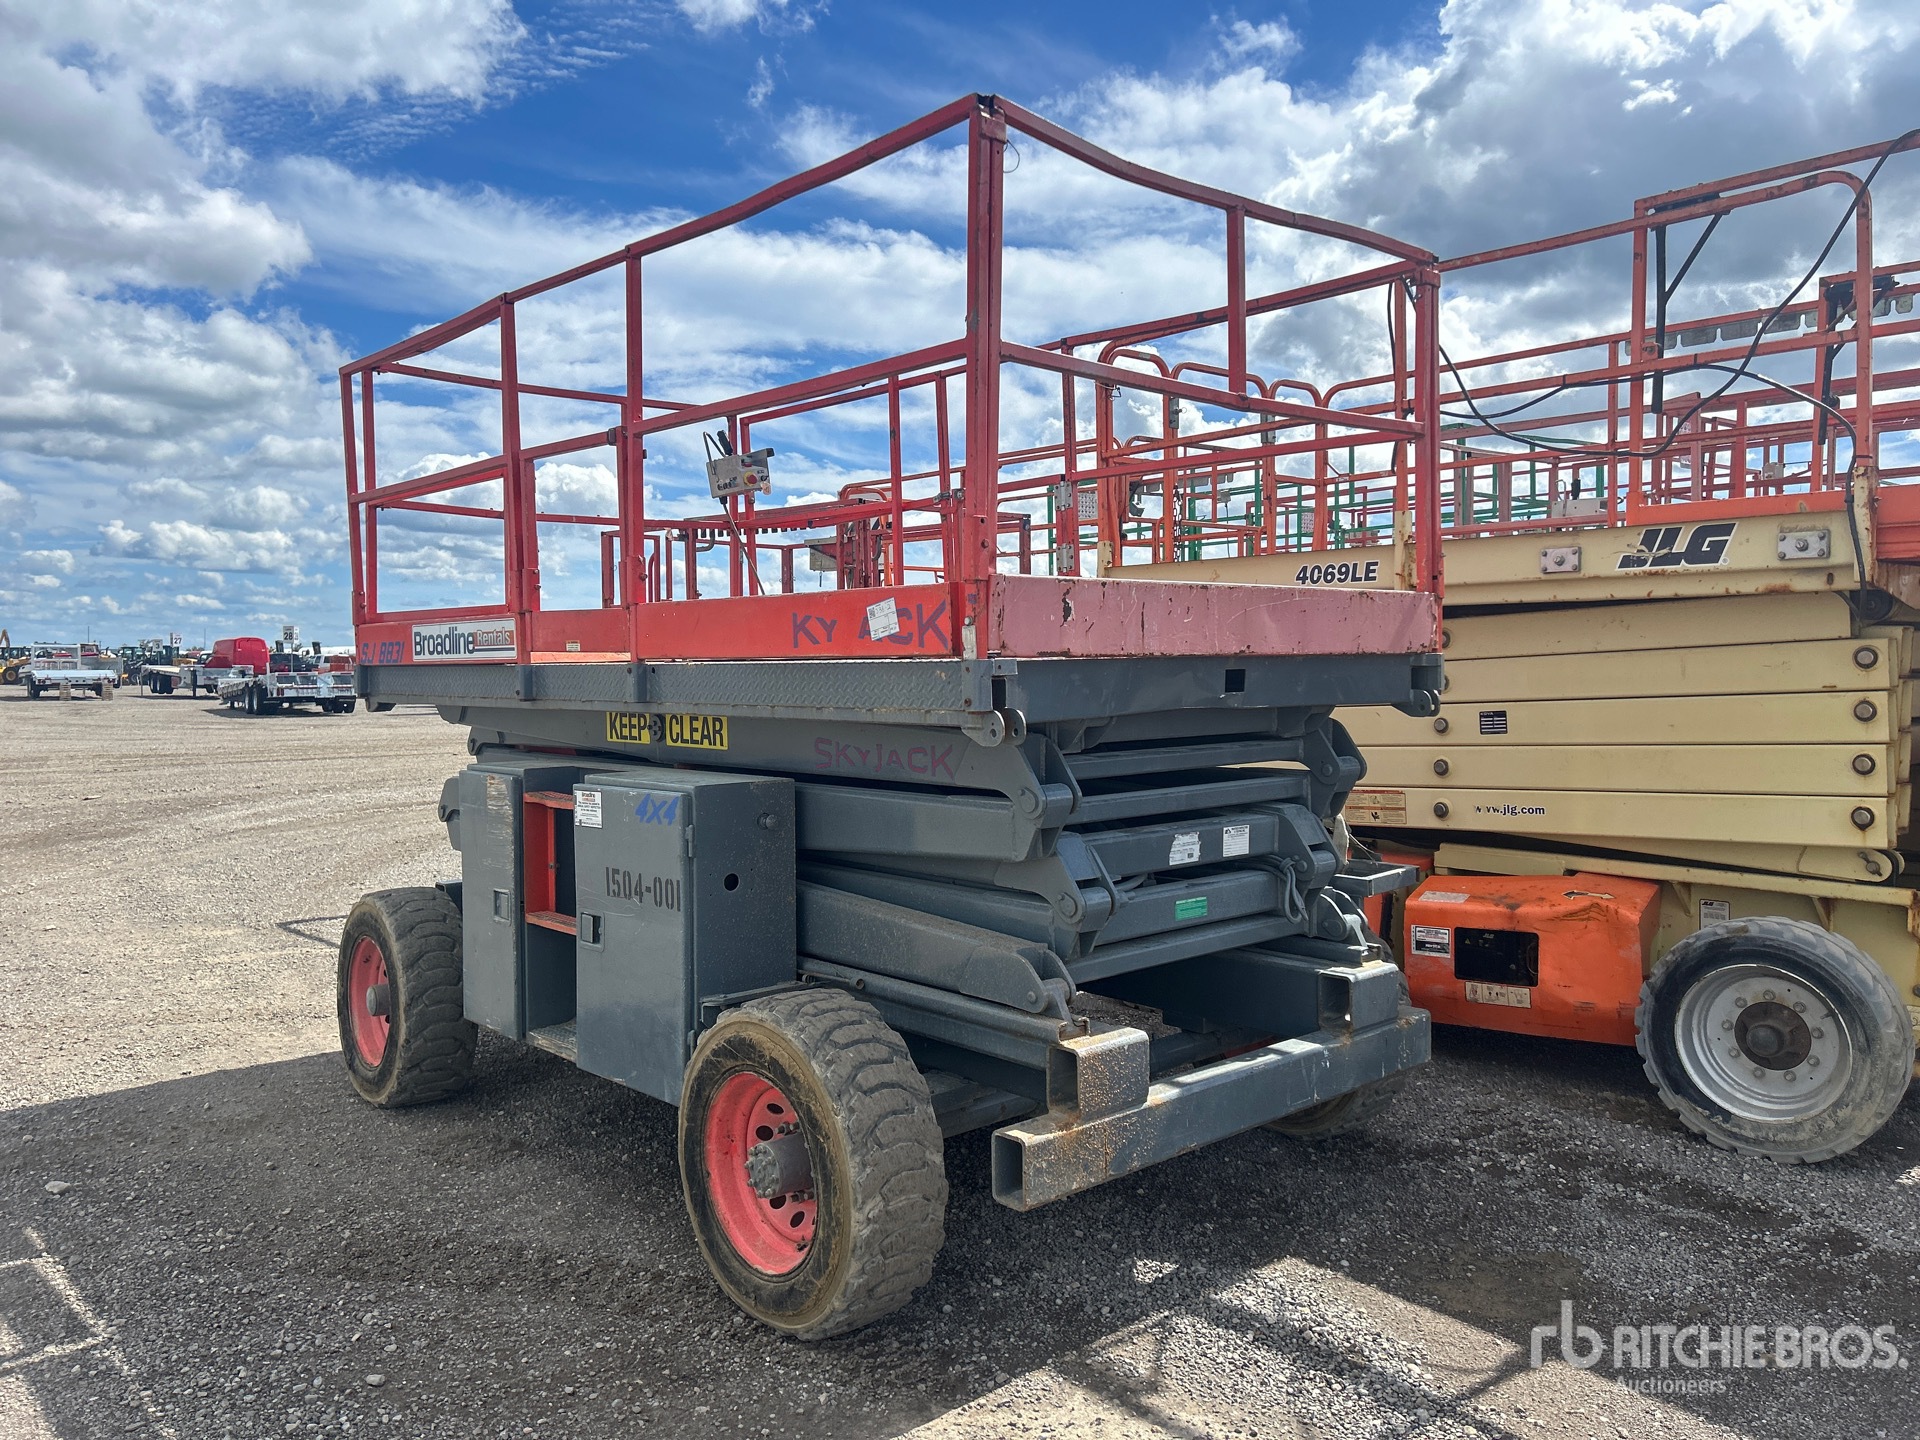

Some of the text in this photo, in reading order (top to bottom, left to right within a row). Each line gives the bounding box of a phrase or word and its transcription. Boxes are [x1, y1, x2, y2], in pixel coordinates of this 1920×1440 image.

[1617, 523, 1737, 569] JLG
[1296, 561, 1379, 585] 4069LE
[173, 637, 182, 645] 27
[283, 632, 293, 641] 28
[414, 627, 511, 656] Broadline Rentals
[360, 640, 406, 664] SJ 8831
[609, 712, 725, 747] KEEP CLEAR
[813, 736, 955, 780] SKYJACK
[605, 866, 681, 912] 1504-001
